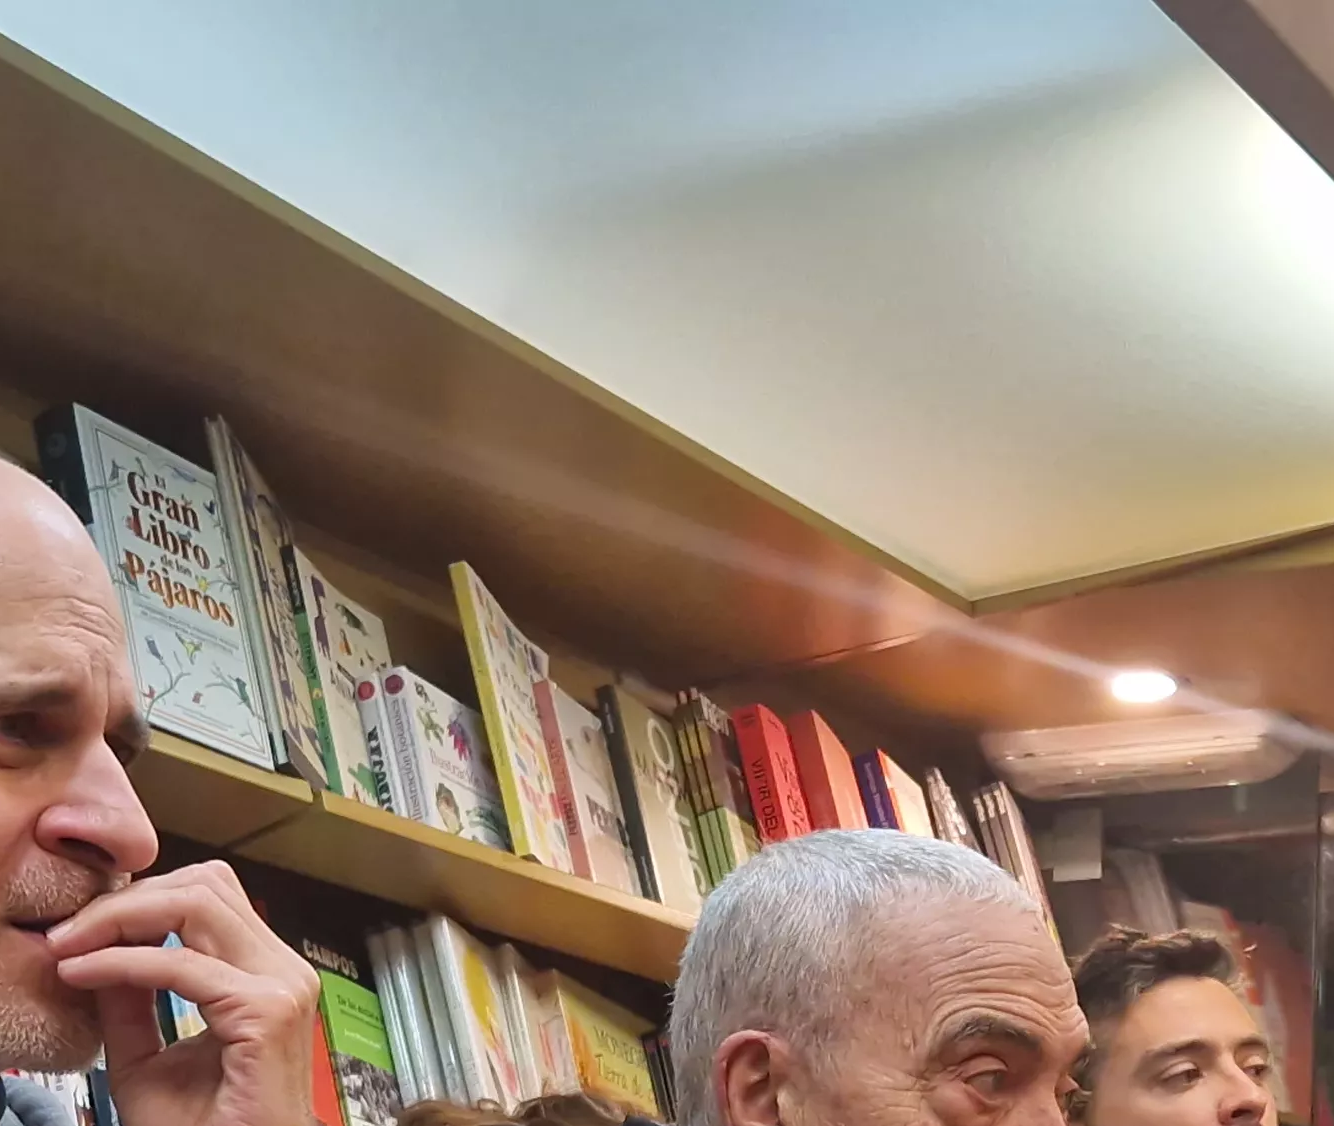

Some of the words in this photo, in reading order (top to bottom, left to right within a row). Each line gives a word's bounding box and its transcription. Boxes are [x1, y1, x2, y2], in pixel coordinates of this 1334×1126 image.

[127, 472, 201, 533] Gran
[130, 504, 211, 570] Libro
[123, 548, 234, 628] Pájaros
[302, 937, 359, 980] CAMPOS
